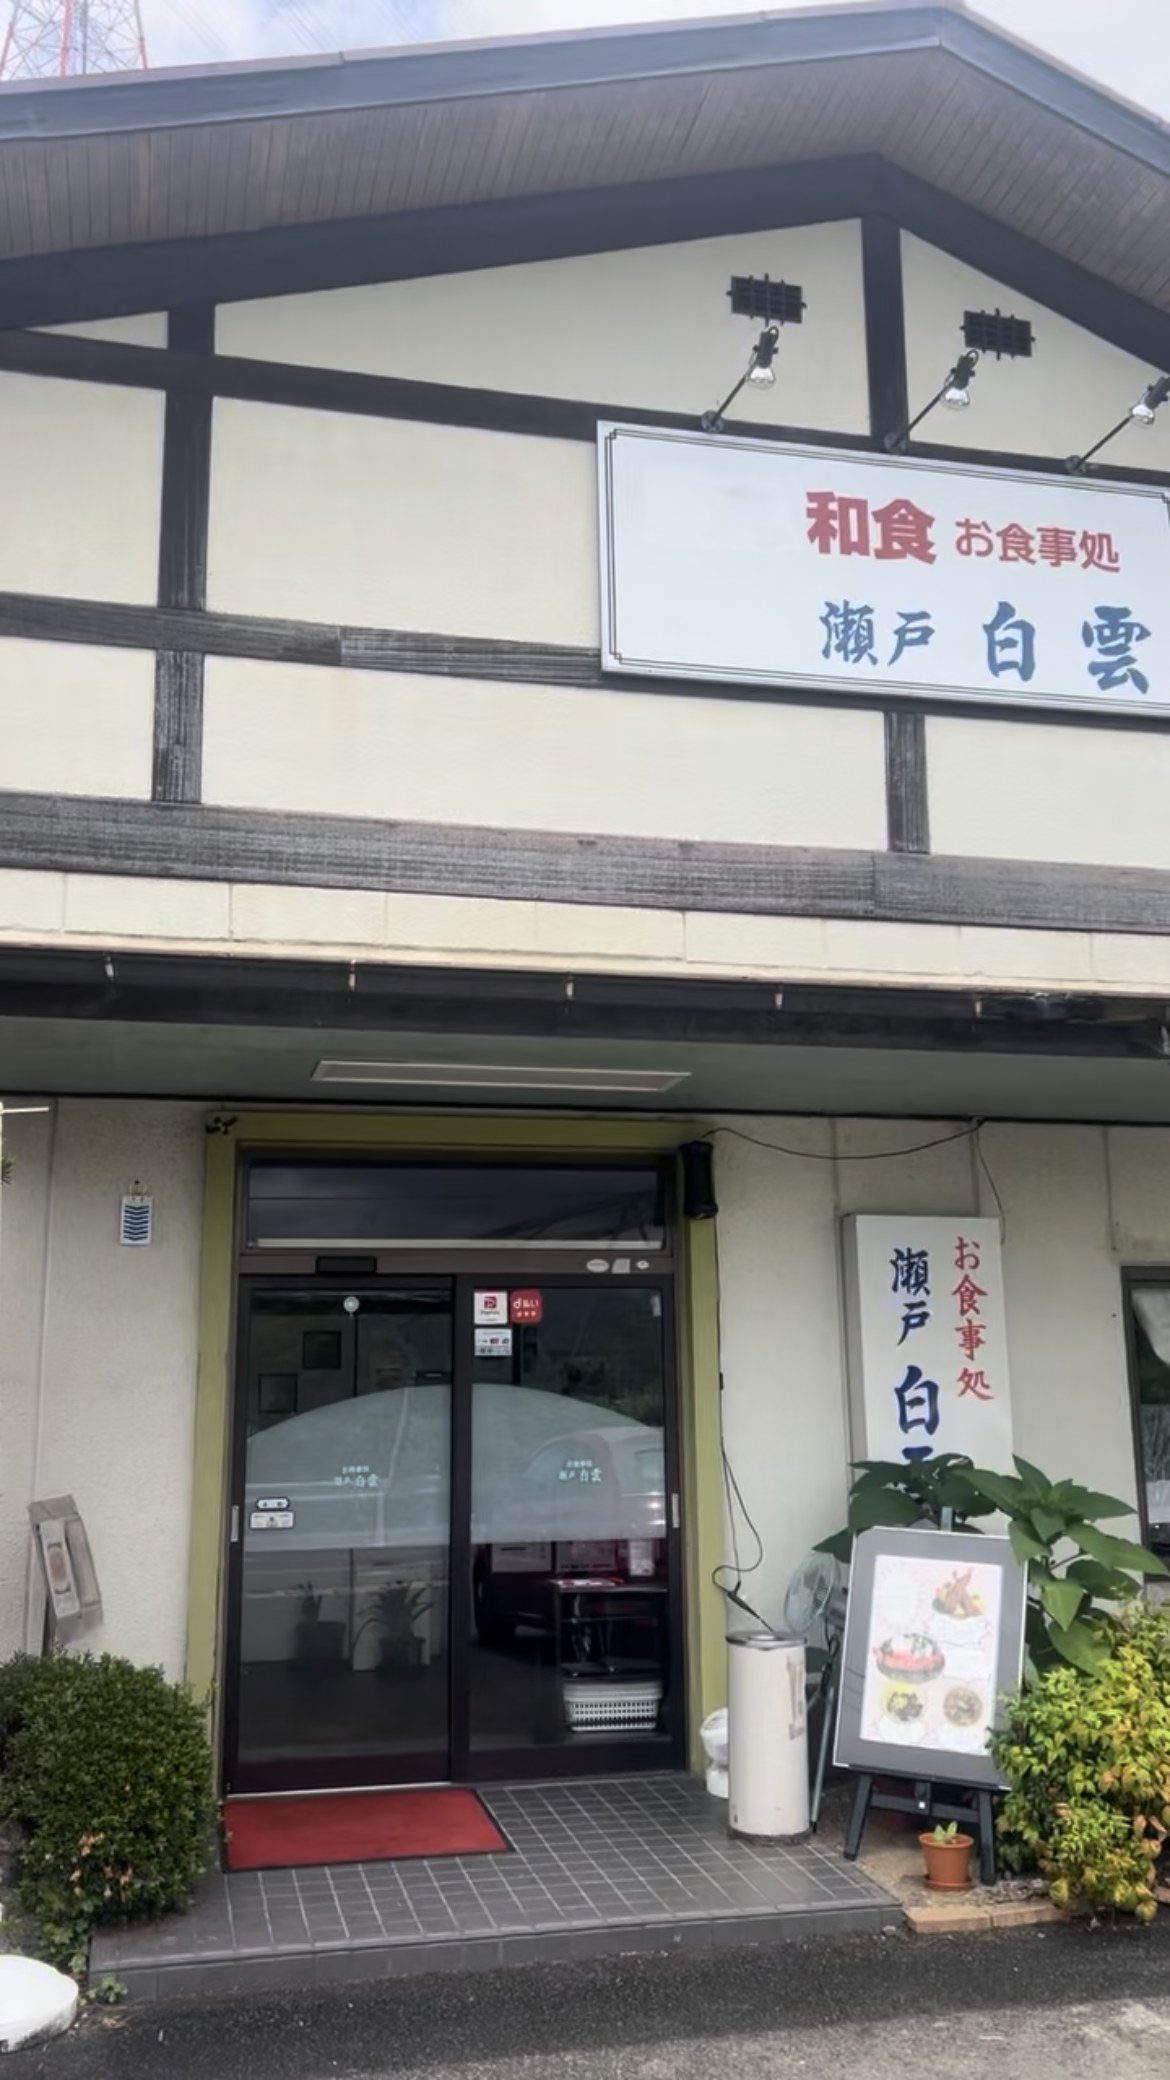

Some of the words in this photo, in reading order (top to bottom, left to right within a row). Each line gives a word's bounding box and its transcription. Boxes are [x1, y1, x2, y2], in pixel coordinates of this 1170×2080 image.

[806, 491, 937, 565] 和食
[955, 518, 1121, 573] お食事処
[982, 601, 1152, 694] 白雲
[952, 1236, 994, 1400] お食事処
[894, 1365, 940, 1463] 白
